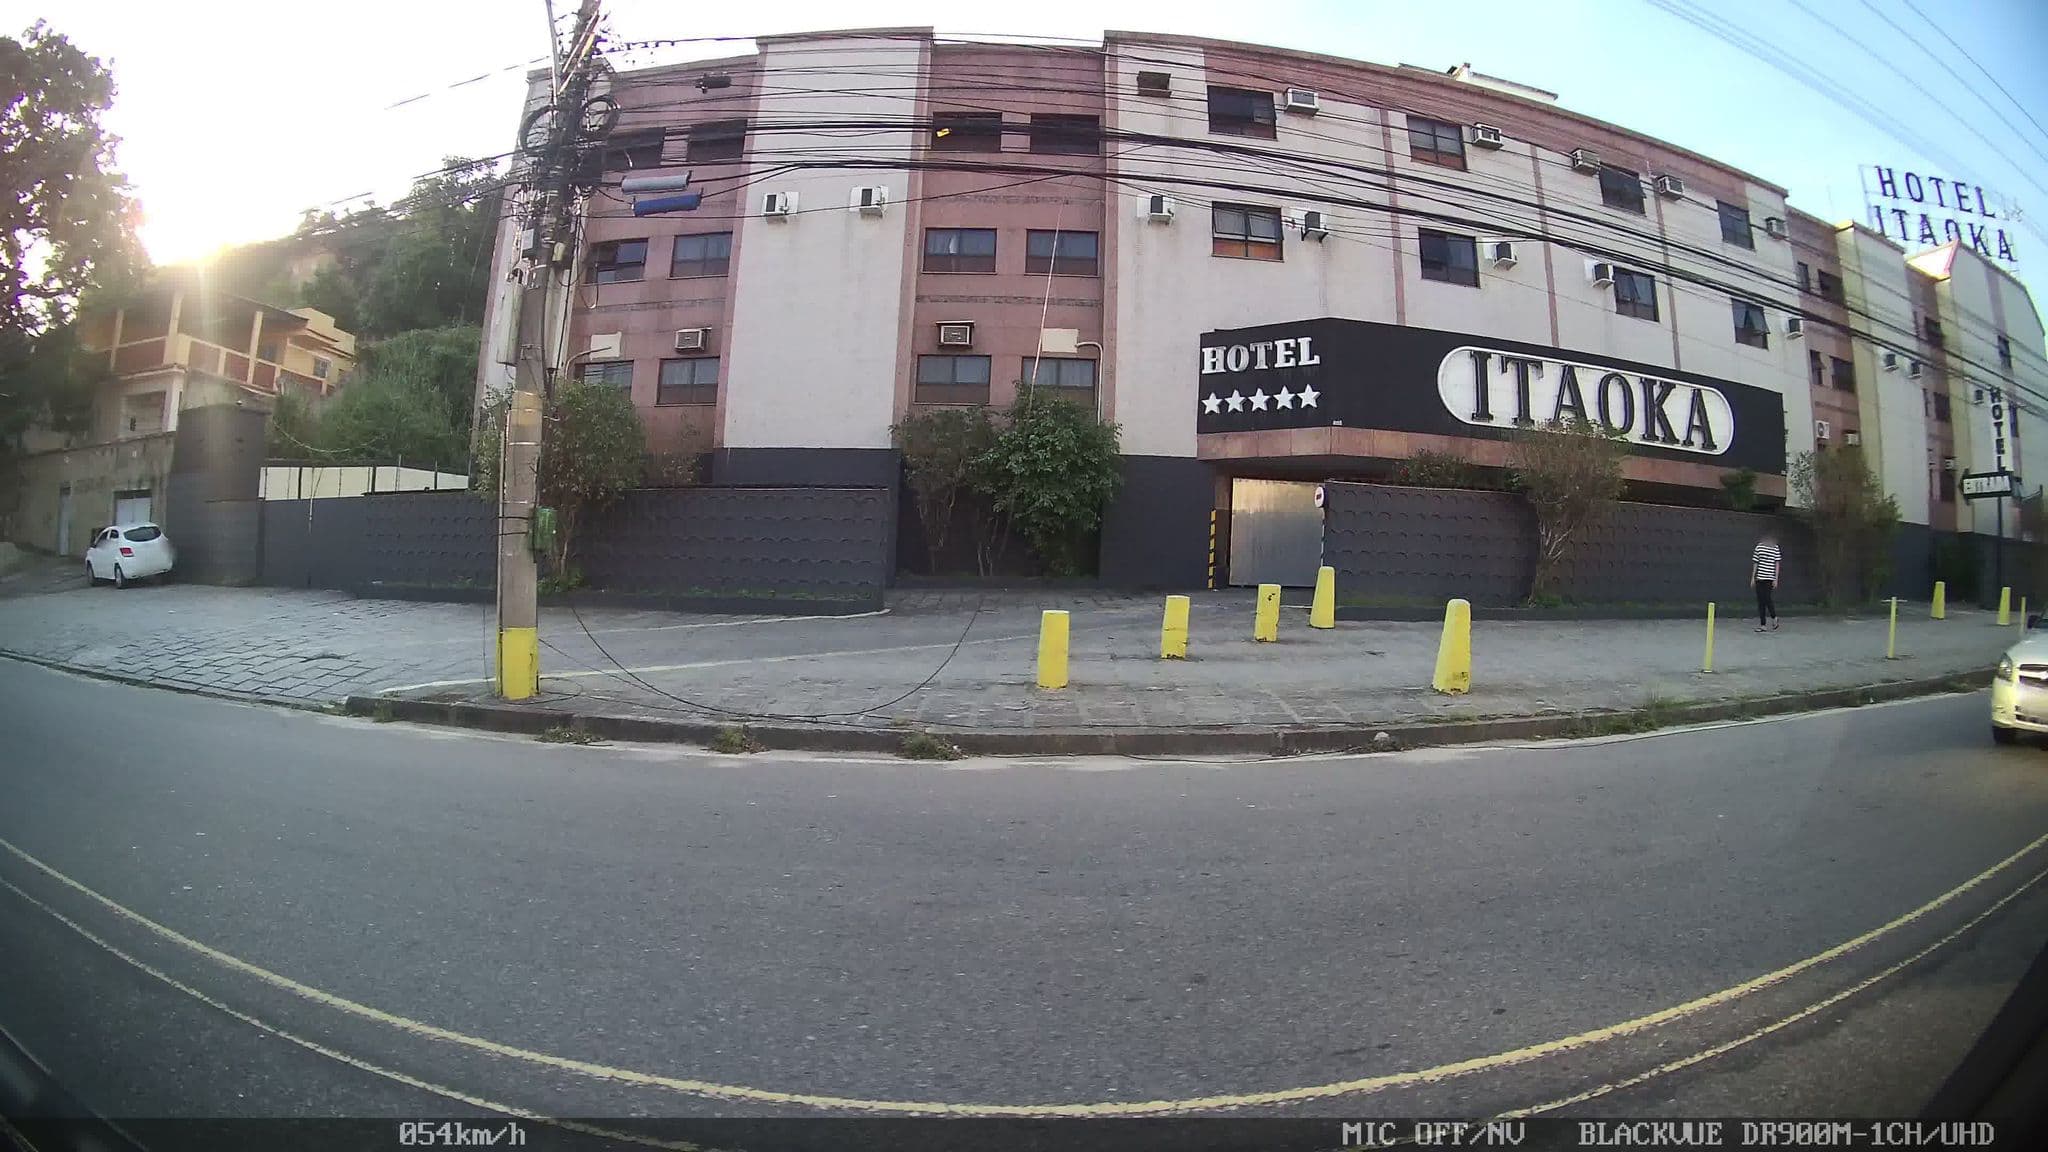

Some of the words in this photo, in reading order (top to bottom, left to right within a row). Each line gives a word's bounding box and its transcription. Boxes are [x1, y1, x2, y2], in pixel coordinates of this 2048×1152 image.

[1875, 165, 1996, 217] HOTEL
[1873, 205, 2018, 262] ITAOKA
[1201, 336, 1321, 376] HOTEL
[1469, 349, 1718, 452] ITAOKA
[1990, 387, 2007, 474] HOTEL
